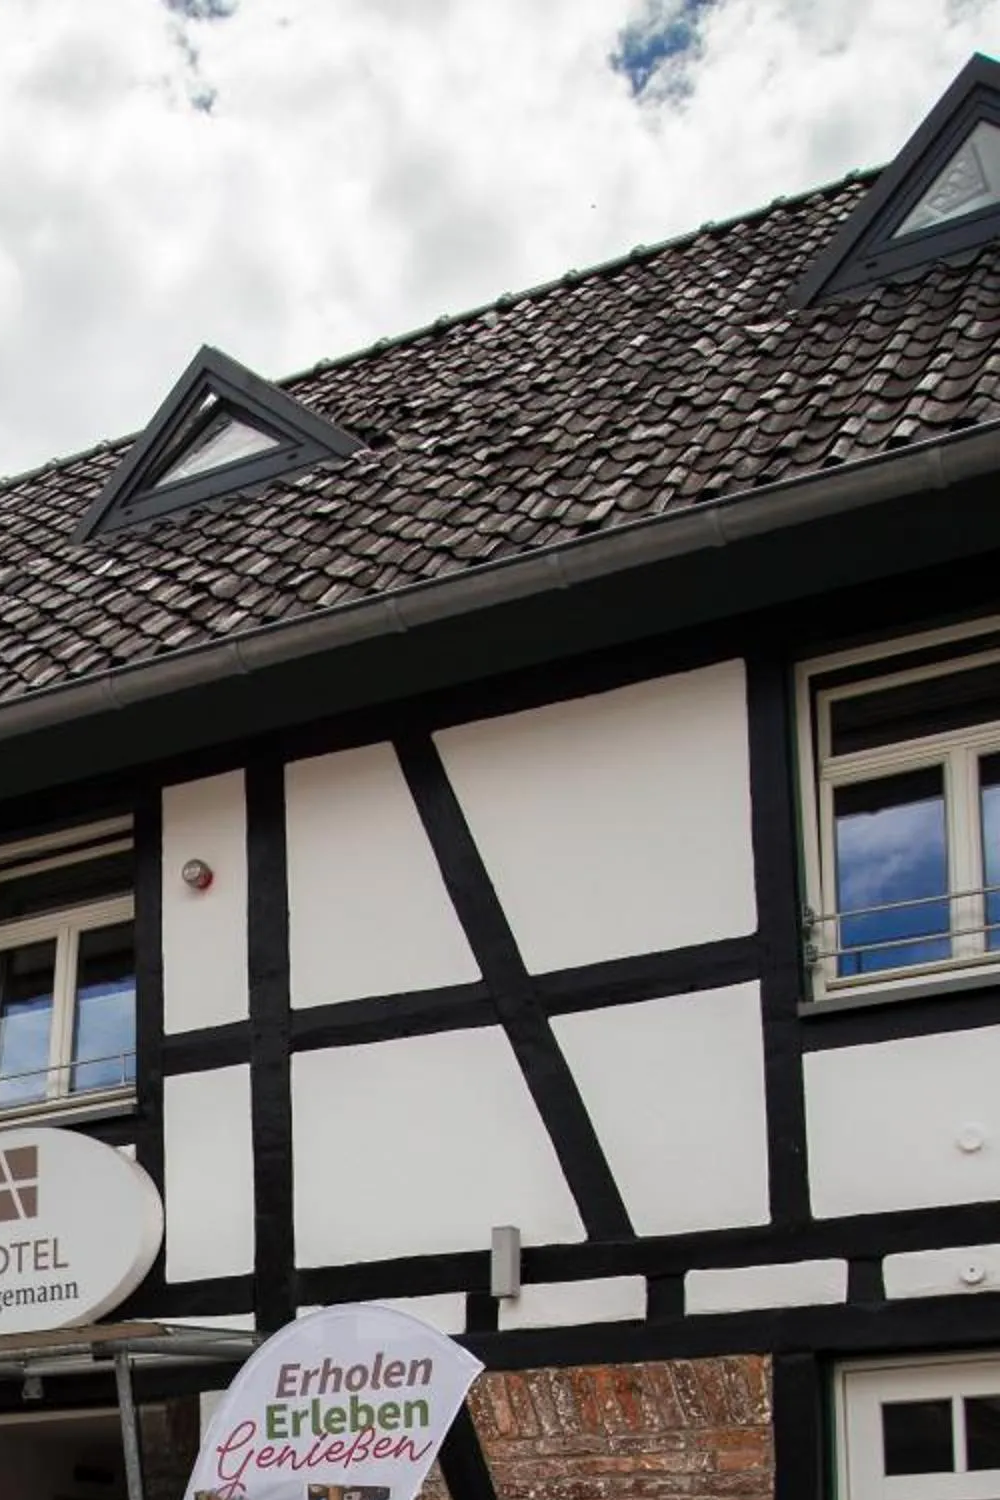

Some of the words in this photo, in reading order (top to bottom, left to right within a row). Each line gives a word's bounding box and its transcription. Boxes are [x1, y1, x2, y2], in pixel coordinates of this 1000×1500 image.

[275, 1353, 433, 1399] Erholen
[265, 1396, 429, 1440] Erleben
[216, 1421, 433, 1499] Genießen
